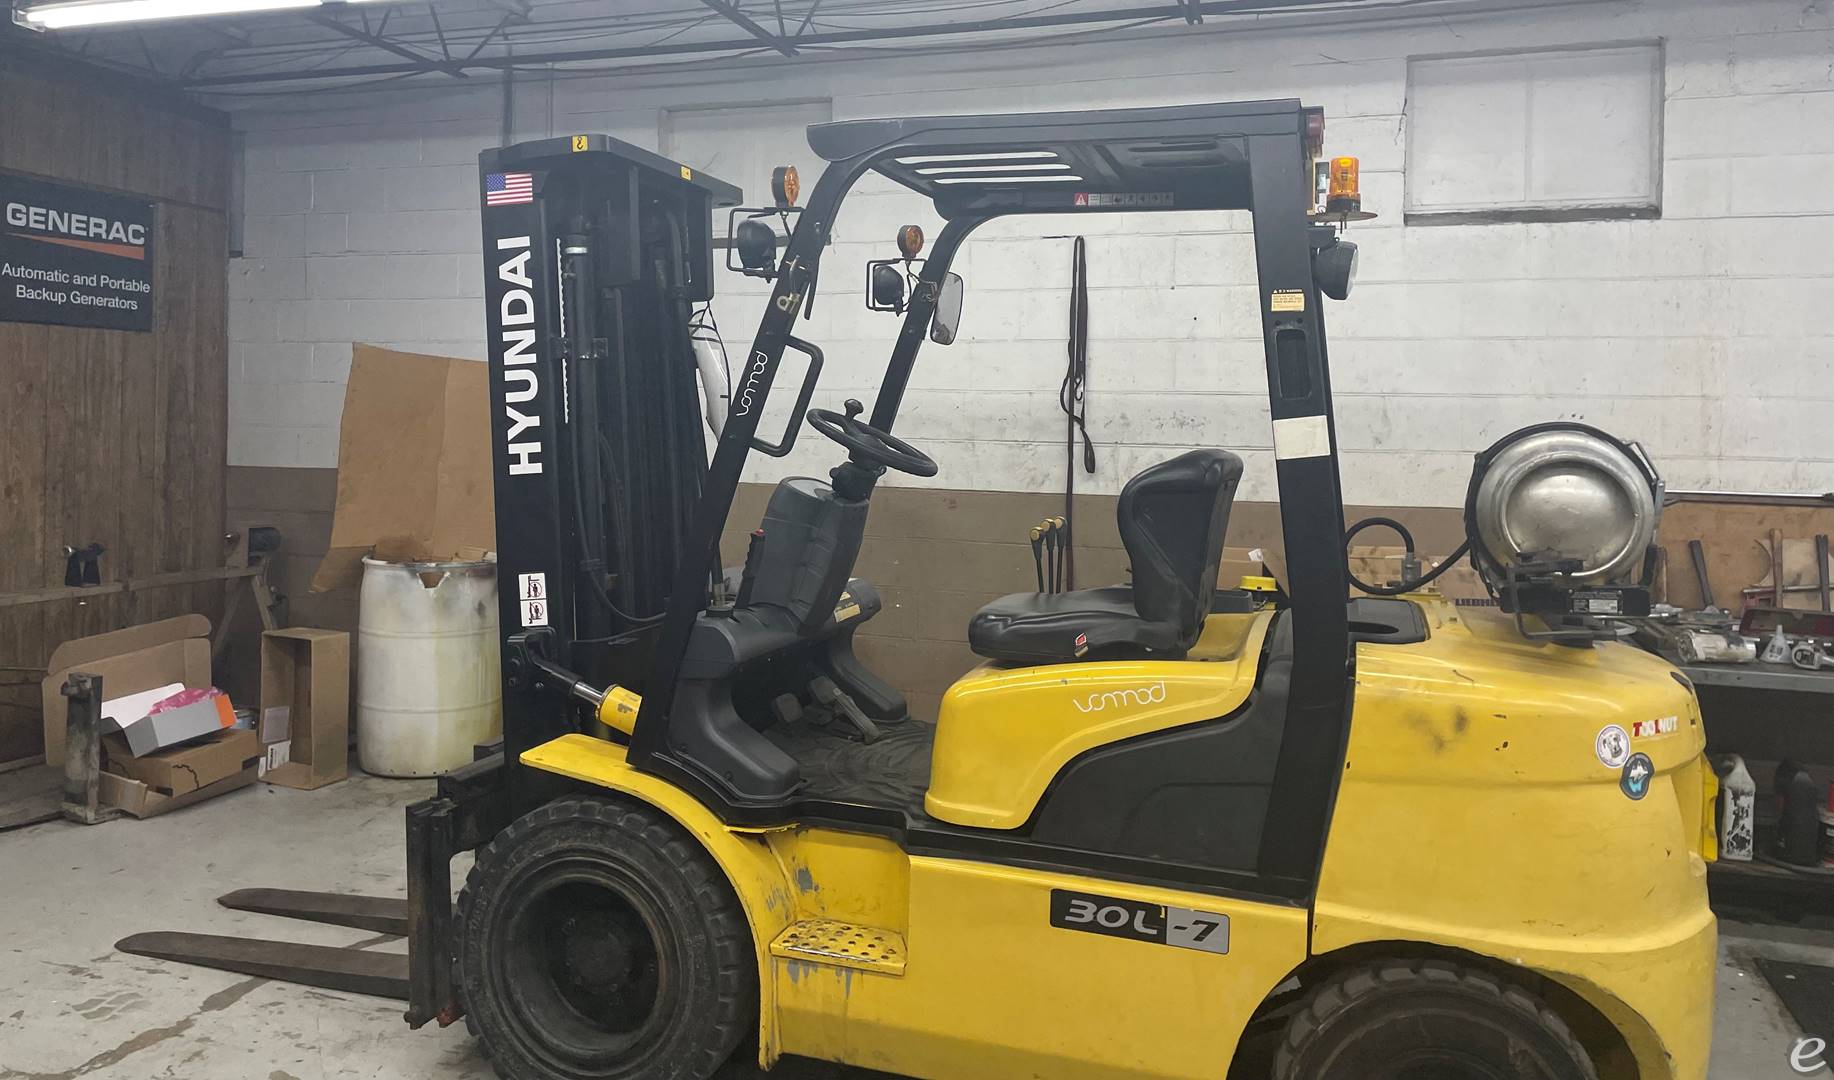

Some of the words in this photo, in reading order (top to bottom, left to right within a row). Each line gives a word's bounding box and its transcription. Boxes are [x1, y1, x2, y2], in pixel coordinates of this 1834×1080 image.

[6, 202, 145, 245] GENERAC
[1, 262, 70, 284] Automatic
[73, 274, 97, 287] and
[100, 275, 150, 293] Portable
[16, 284, 67, 305] Backup
[70, 291, 138, 310] Generators
[497, 236, 543, 475] HYUNDAI
